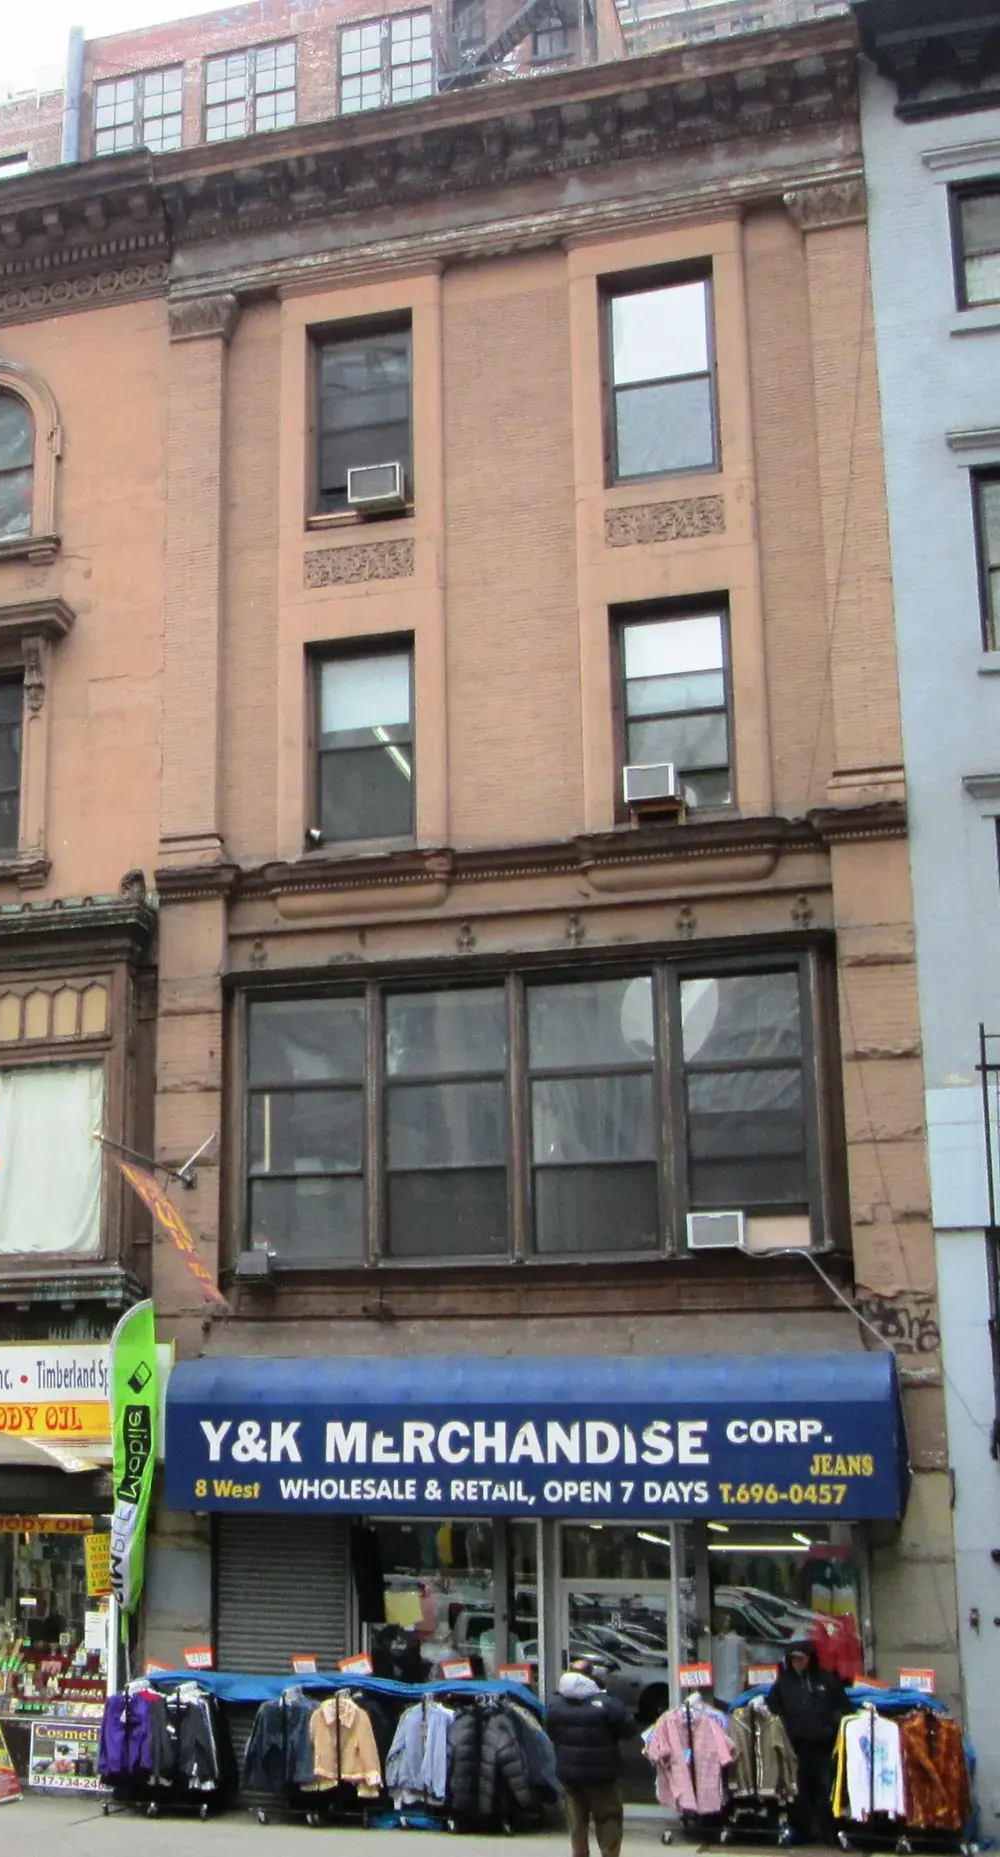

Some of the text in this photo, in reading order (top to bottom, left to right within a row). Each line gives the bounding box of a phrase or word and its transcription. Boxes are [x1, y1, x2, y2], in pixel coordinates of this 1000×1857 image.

[37, 1359, 96, 1389] Timberland
[45, 1407, 83, 1430] OIL
[200, 1420, 832, 1463] Y&K MERCHANDISE CORP.
[809, 1454, 873, 1476] JEANS
[195, 1479, 847, 1506] 8 West WHOLESALE & RETAIL, OPEN 7 DAYS T.696-0457
[54, 1519, 93, 1531] OIL
[35, 1726, 97, 1740] Cosmeti
